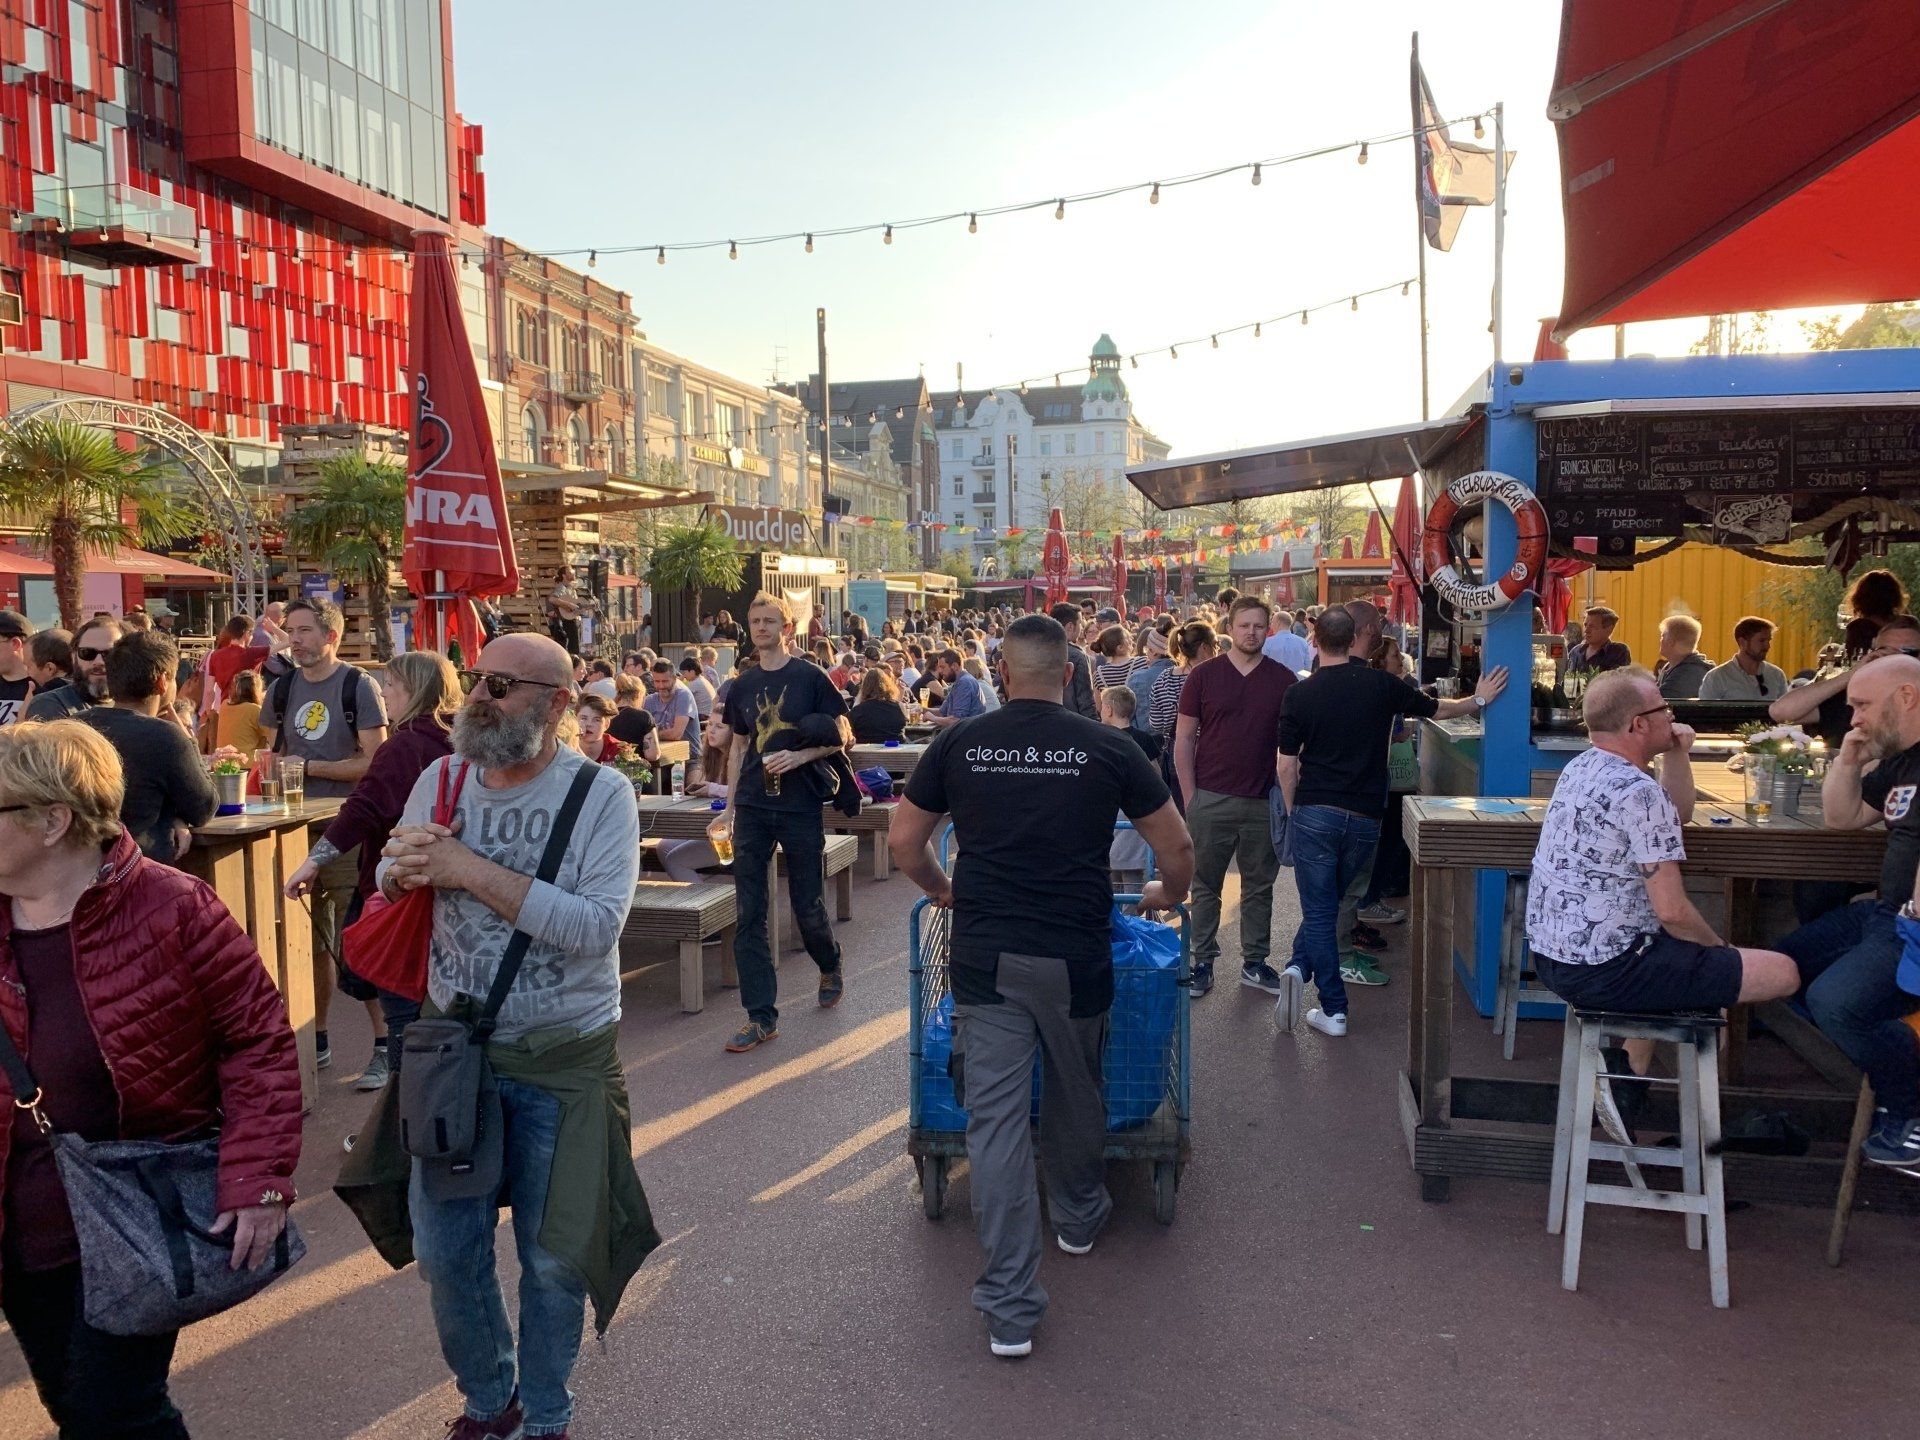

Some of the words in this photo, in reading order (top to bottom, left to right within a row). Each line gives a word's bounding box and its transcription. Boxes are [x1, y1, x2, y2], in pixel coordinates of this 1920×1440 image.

[1560, 459, 1591, 475] ERDINGER
[1591, 459, 1616, 475] WEIZEN
[1553, 509, 1570, 528] 2
[1596, 508, 1637, 518] PFAND
[1612, 518, 1664, 529] DEPOSIT
[1432, 572, 1497, 608] HEIMATHAFEN
[965, 745, 1020, 762] clean
[1024, 746, 1040, 763] &
[1044, 747, 1088, 765] safe
[971, 764, 990, 773] Glas-
[990, 765, 1006, 774] und
[1006, 765, 1080, 777] Gebäudereinigung
[479, 807, 562, 846] LOO
